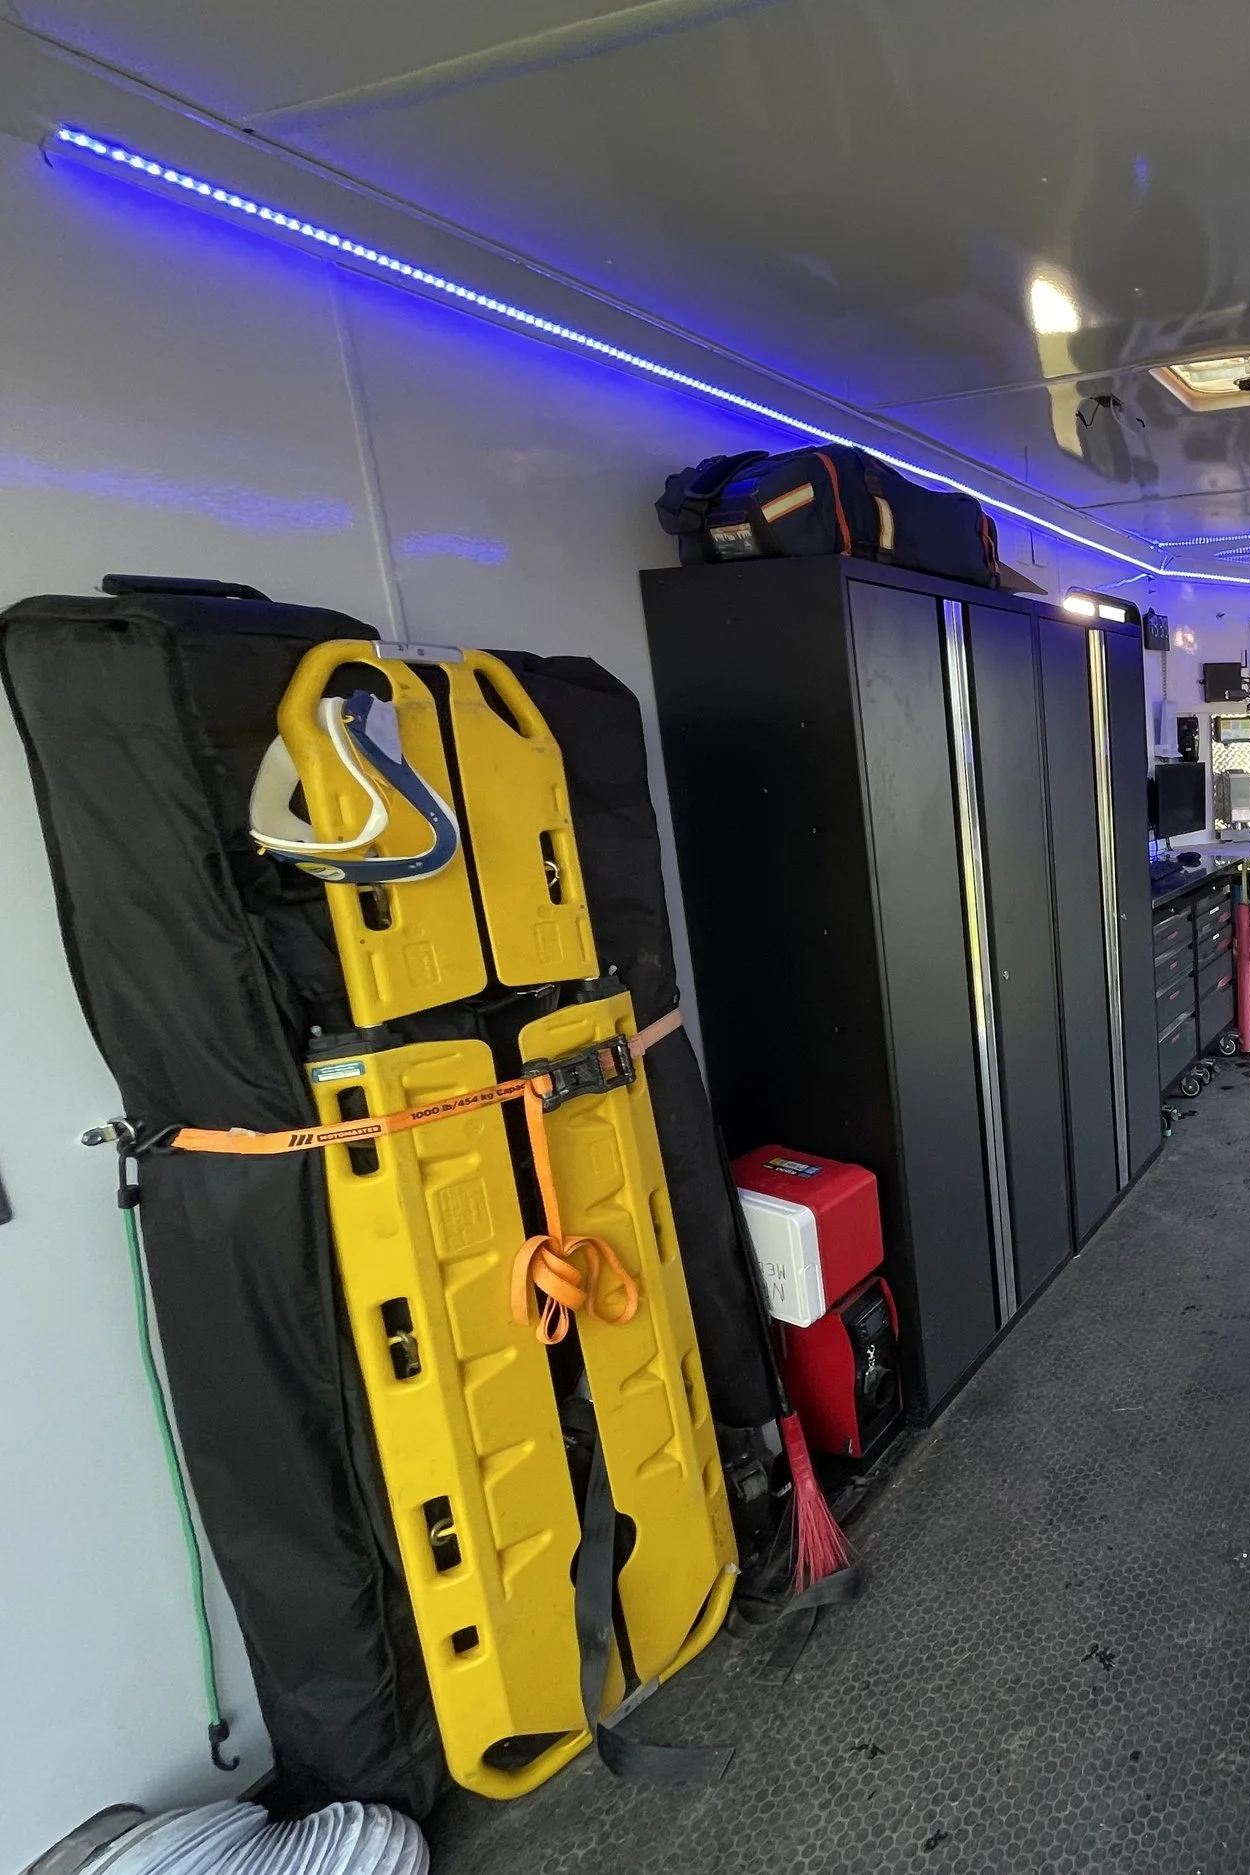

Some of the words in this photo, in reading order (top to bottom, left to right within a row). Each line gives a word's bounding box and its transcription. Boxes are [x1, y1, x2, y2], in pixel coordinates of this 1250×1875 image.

[411, 1106, 440, 1121] 1000
[442, 1096, 479, 1114] lb/454
[319, 1126, 380, 1142] MOTOMASTER
